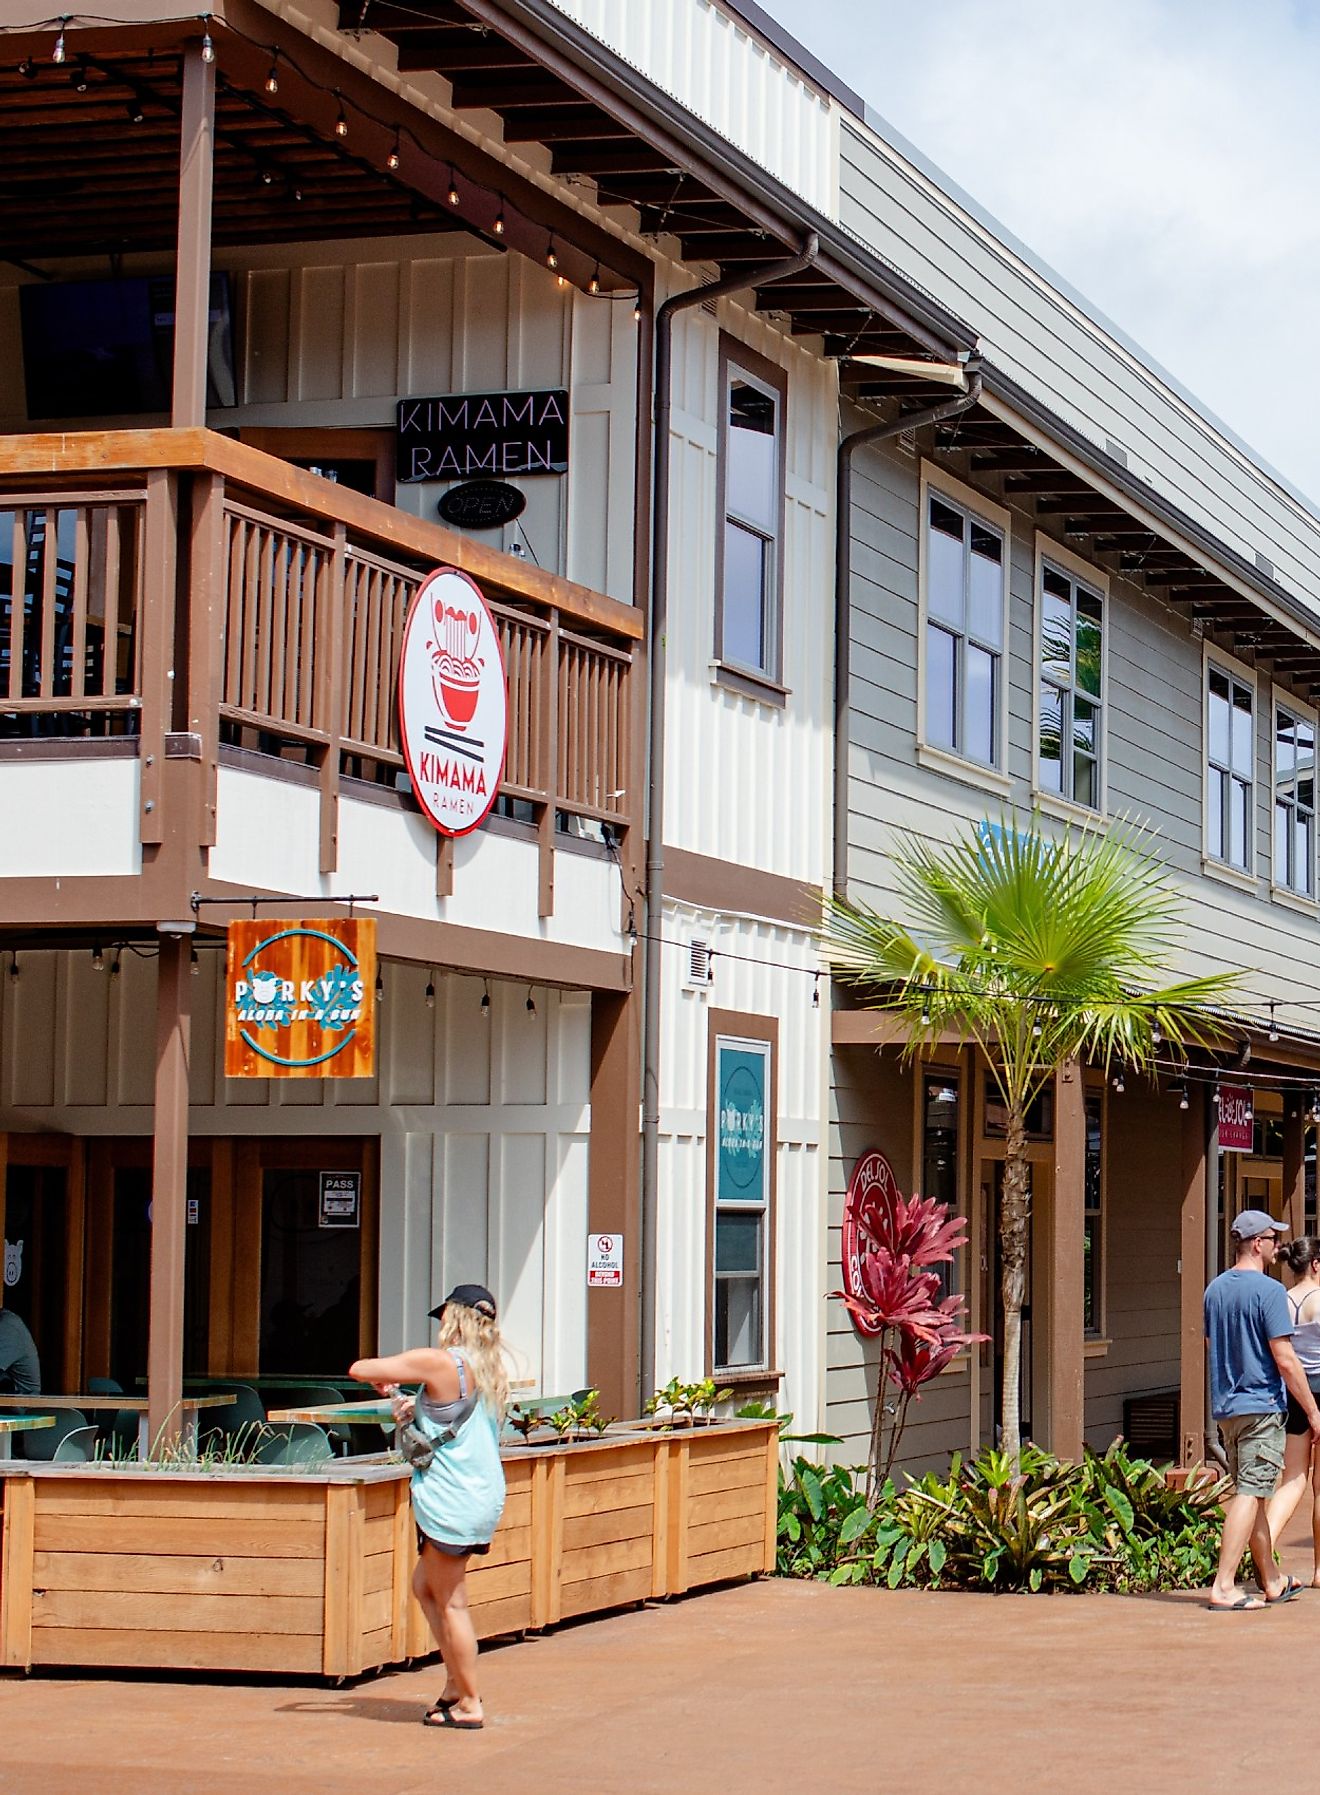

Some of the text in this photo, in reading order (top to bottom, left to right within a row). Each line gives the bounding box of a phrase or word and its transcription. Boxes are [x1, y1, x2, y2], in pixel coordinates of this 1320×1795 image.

[401, 396, 564, 432] KIMAMA
[412, 440, 550, 476] RAMEN
[420, 752, 487, 797] KIMAMA
[434, 792, 474, 815] RAMEN
[326, 1180, 354, 1189] PASS
[591, 1261, 618, 1269] ALCOHOL
